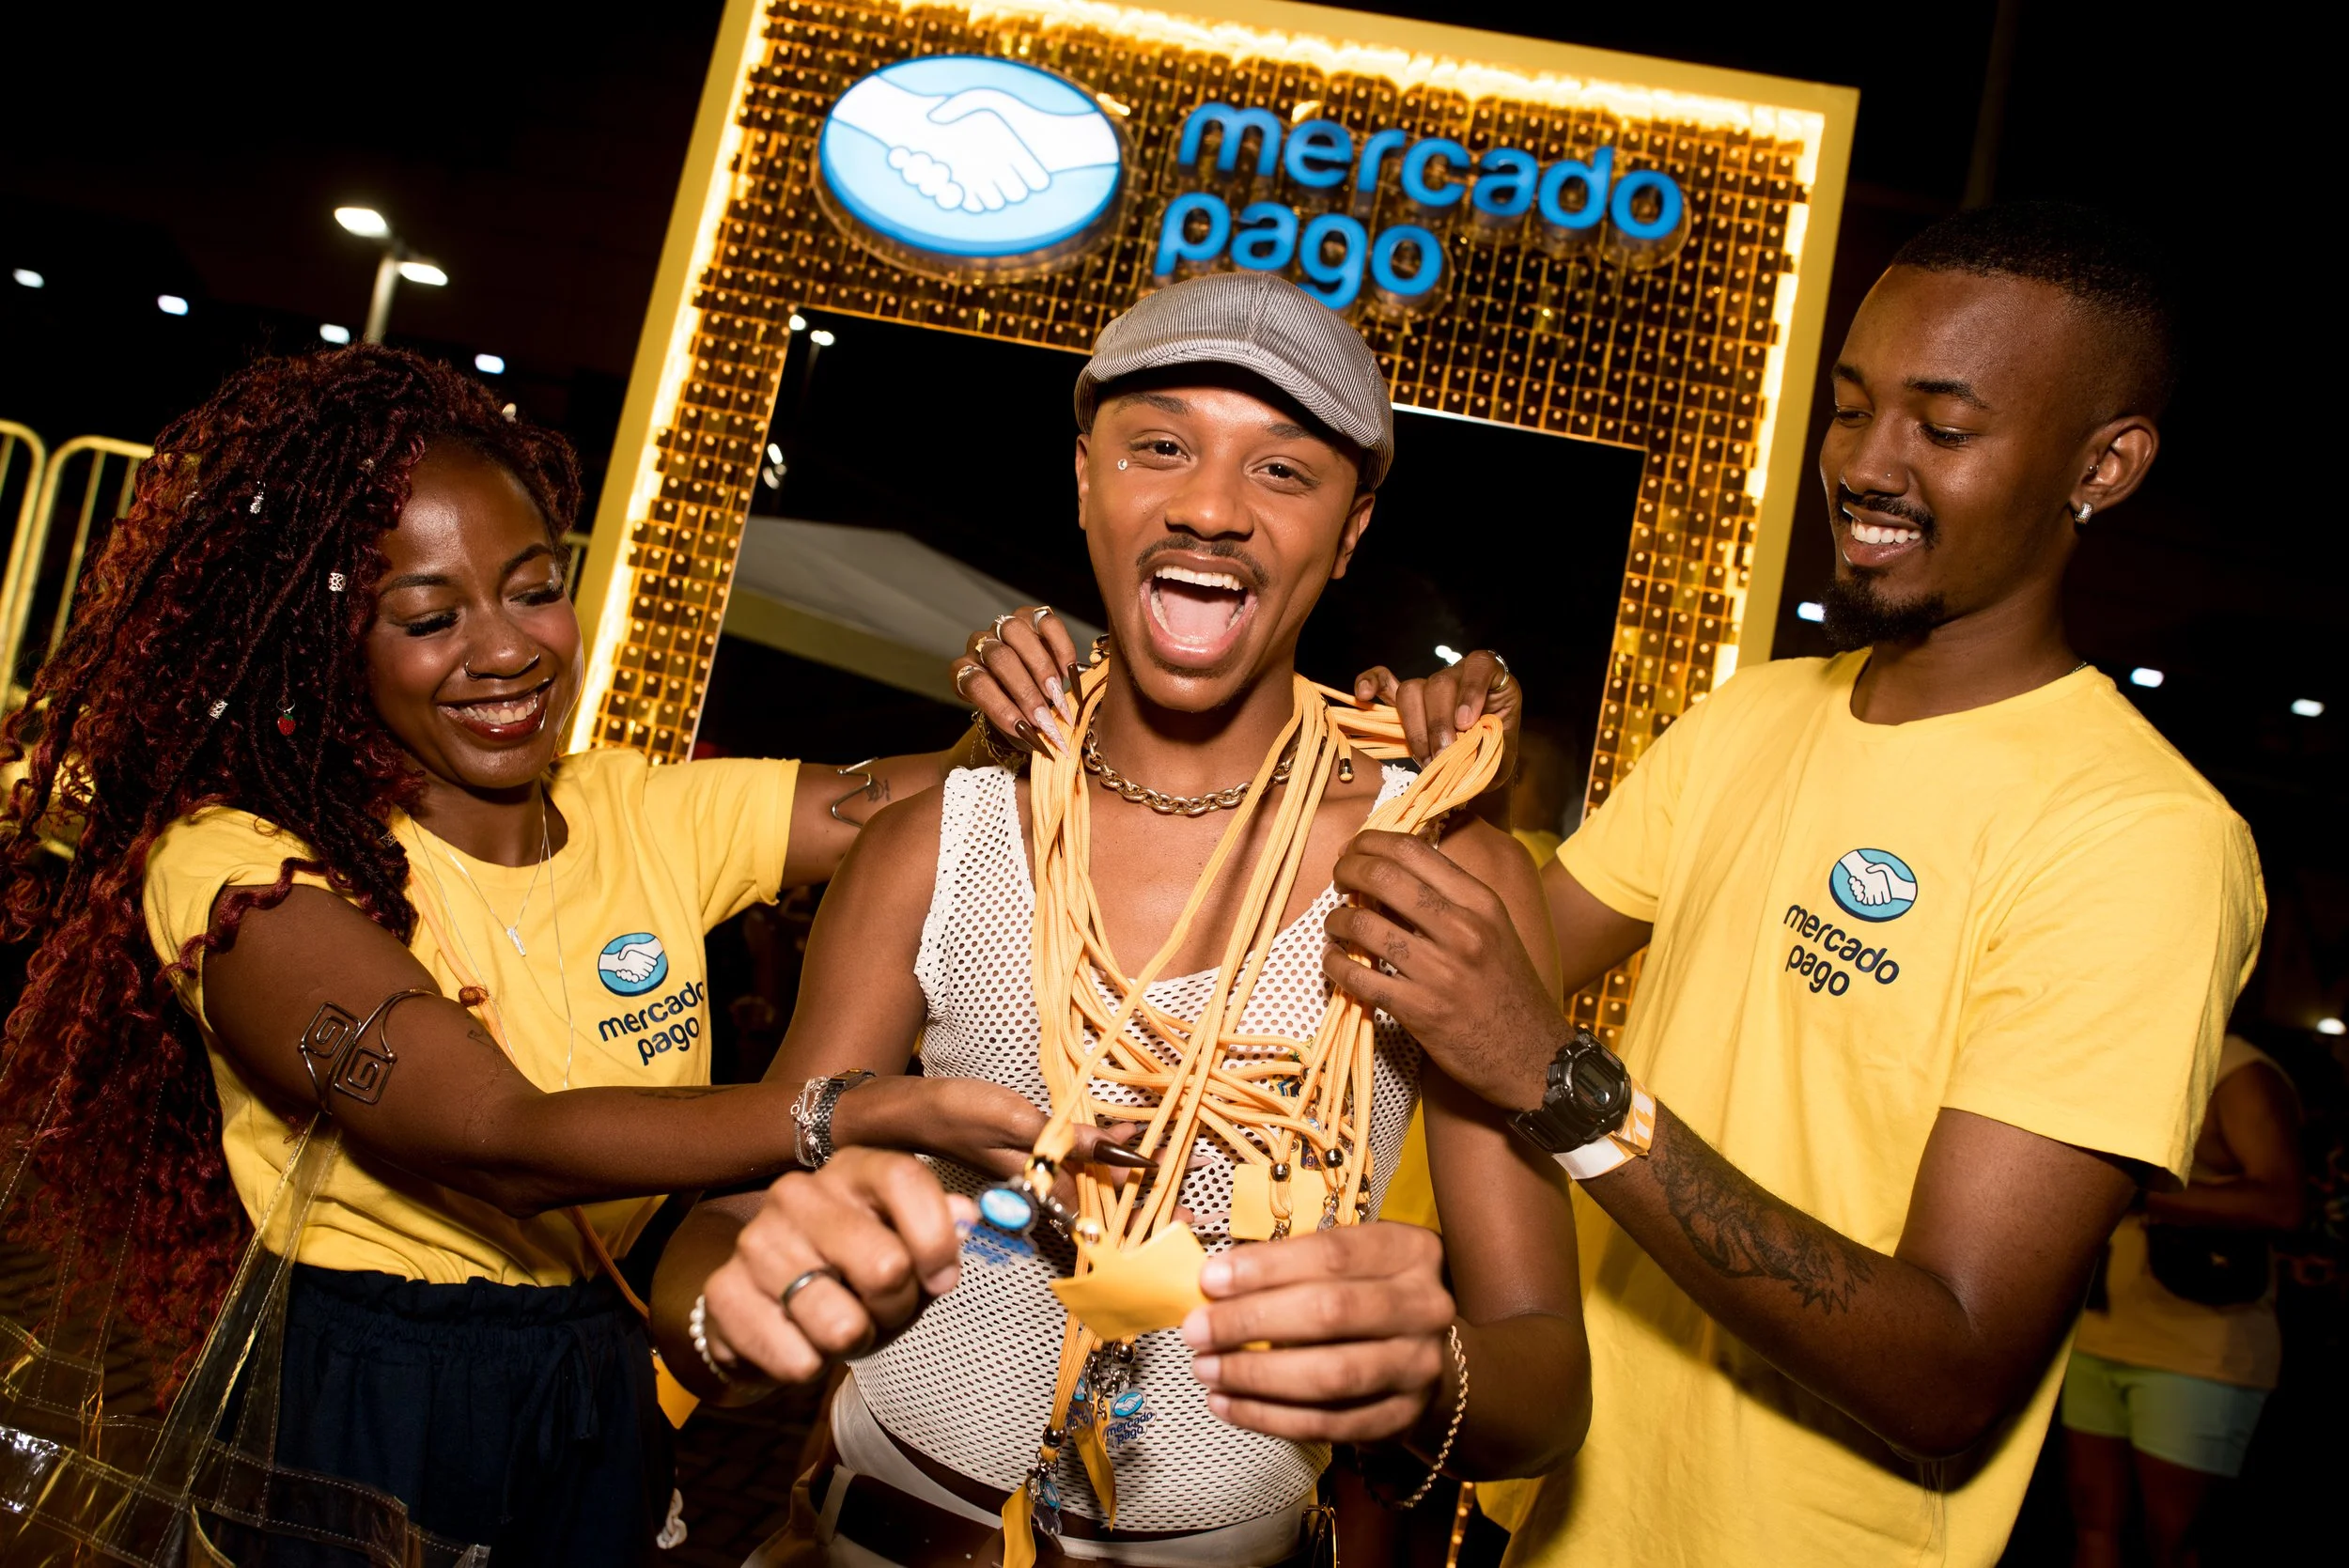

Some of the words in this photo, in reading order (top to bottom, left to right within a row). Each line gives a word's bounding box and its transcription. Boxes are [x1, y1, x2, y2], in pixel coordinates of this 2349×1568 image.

[1178, 102, 1684, 241] mercado
[1154, 192, 1443, 310] pago
[1783, 904, 1900, 985] mercado
[1785, 944, 1850, 997] pago
[637, 1017, 700, 1066] pago
[1106, 1411, 1154, 1436] mercado
[1116, 1425, 1144, 1445] pago
